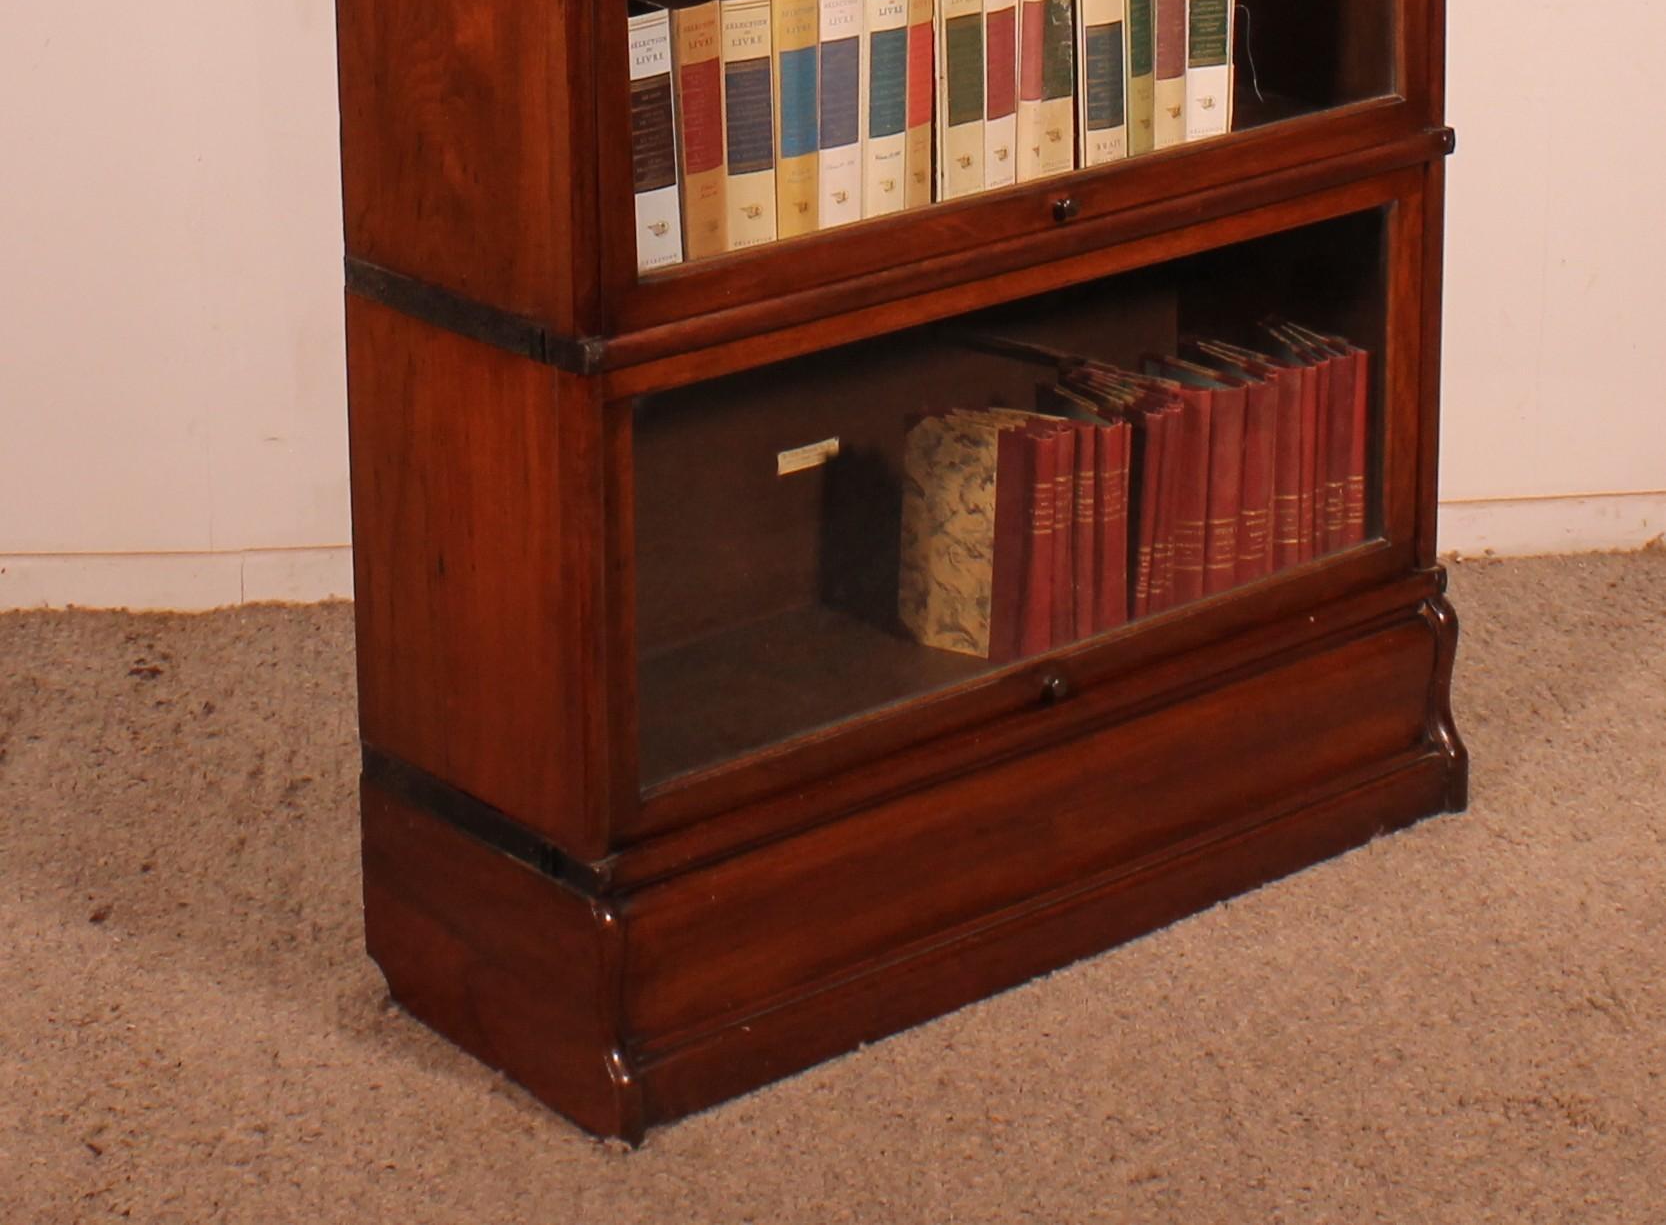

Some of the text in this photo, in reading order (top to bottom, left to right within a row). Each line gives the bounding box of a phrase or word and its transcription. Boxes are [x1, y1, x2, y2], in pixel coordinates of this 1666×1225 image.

[879, 6, 903, 17] LIVRE
[732, 35, 763, 47] LIVRE
[636, 52, 664, 65] LIVRE
